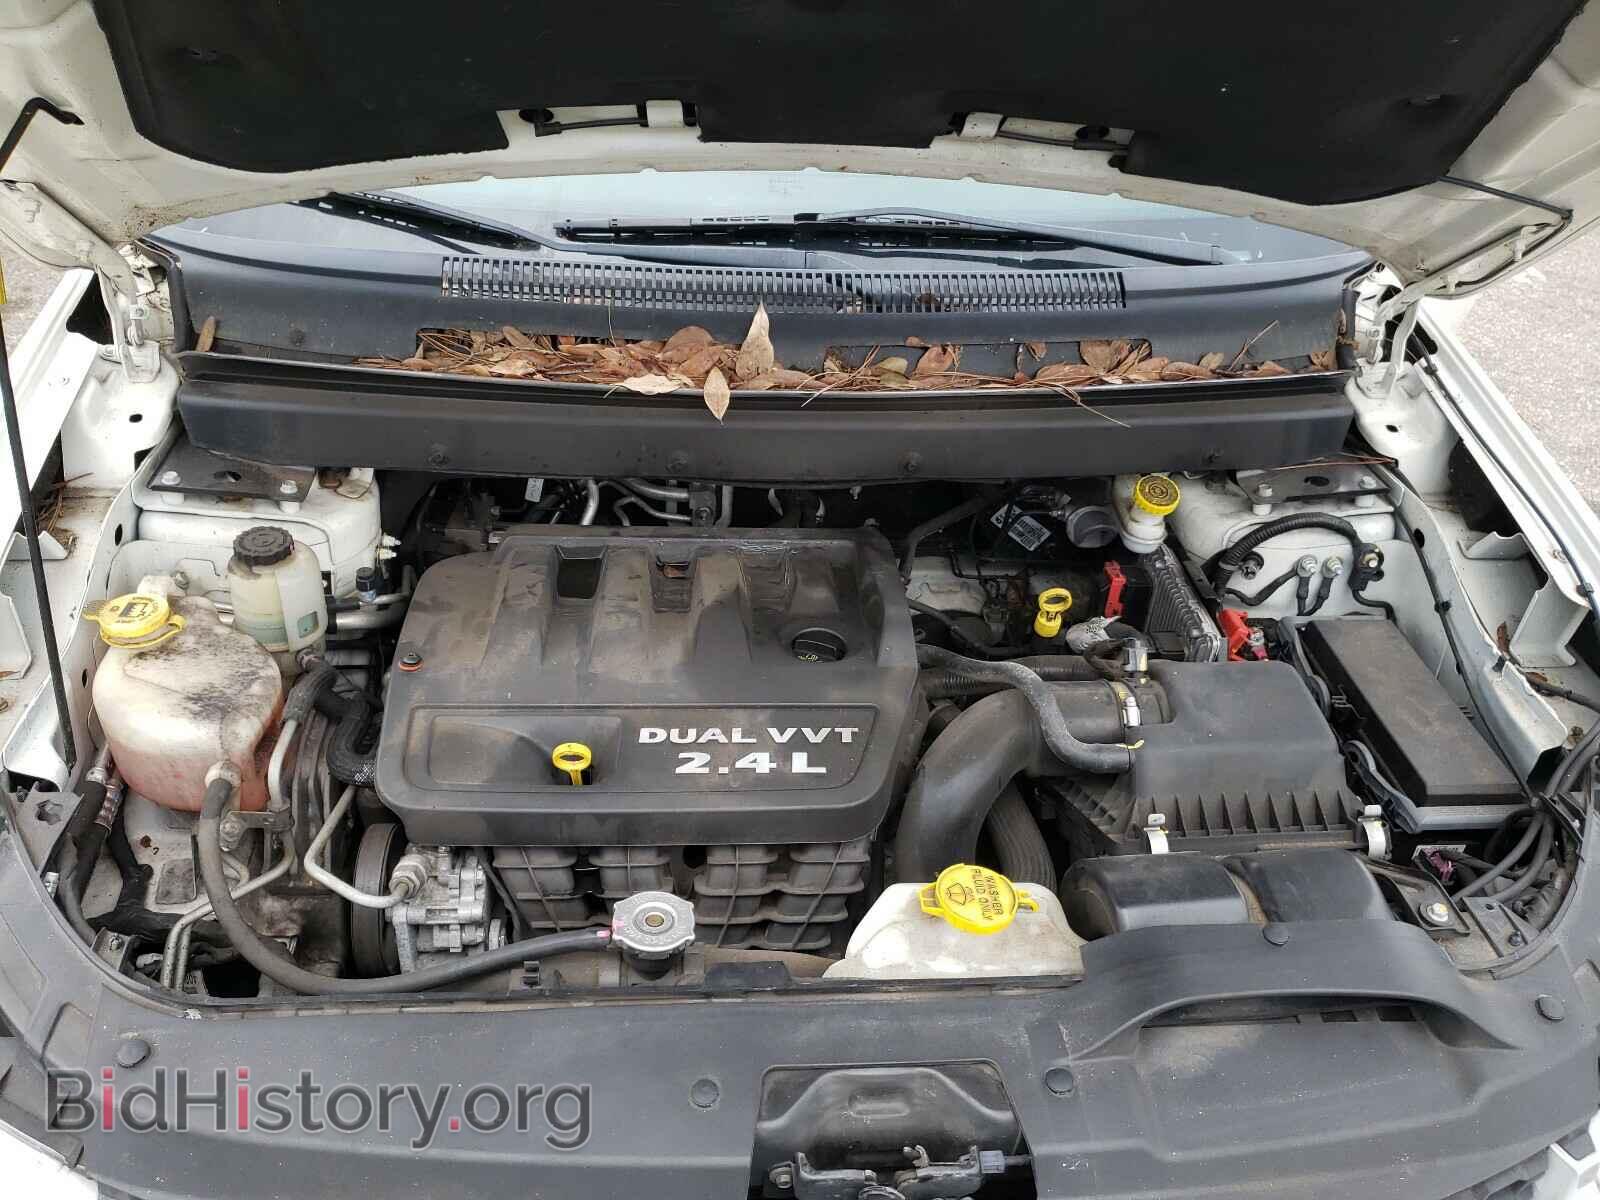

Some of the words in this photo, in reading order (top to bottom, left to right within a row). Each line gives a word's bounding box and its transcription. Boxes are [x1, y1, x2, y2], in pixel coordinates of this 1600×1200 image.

[638, 727, 757, 744] DUAL
[766, 727, 859, 744] VVT
[675, 751, 777, 774] 2.4
[791, 751, 827, 774] L
[971, 868, 986, 894] FLUID
[984, 875, 1004, 915] WASHER
[978, 896, 993, 920] ONLY
